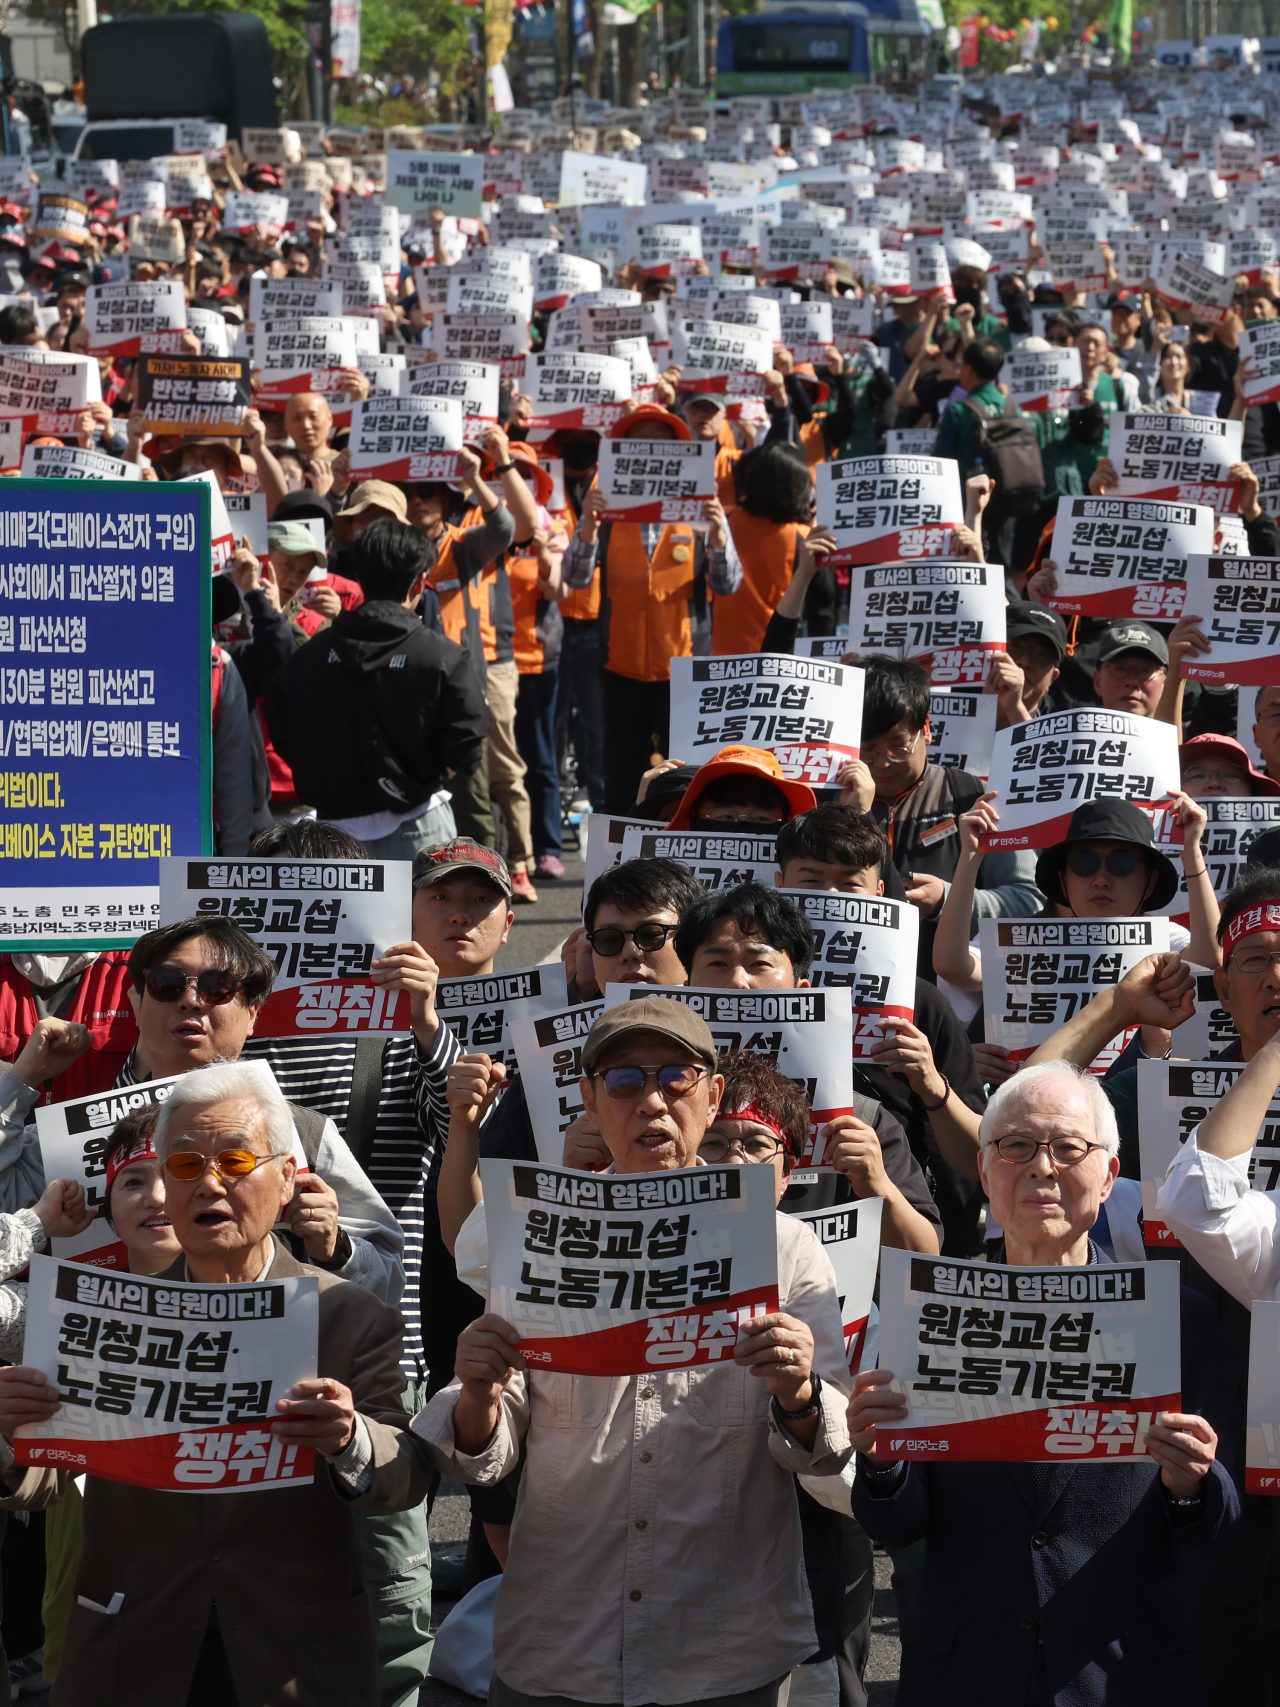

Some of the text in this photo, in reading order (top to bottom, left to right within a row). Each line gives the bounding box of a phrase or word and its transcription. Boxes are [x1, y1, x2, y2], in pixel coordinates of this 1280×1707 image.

[1133, 416, 1222, 437] 열사의 염원이다!
[841, 459, 938, 477] 열사의 염원이다!
[1122, 458, 1221, 481] 노동기본권
[832, 504, 943, 530] 노동기본권
[1083, 502, 1191, 526] 열사의 염원이다!
[156, 513, 195, 552] 구입)
[70, 564, 136, 602] 파산절차
[141, 566, 174, 602] 의결
[872, 568, 981, 585] 열사의 염원이다!
[1065, 552, 1186, 582] 노동기본권
[1222, 561, 1272, 581] 열사의
[20, 616, 87, 653] 파산신청
[860, 620, 983, 648] 노동기본권
[0, 668, 155, 705] 30분 법원 파산선고
[708, 660, 836, 687] 열사의 염원이다!
[147, 721, 180, 757] 통보
[693, 715, 835, 747] 노동기본권
[1024, 712, 1073, 737] 열사의
[1008, 772, 1154, 804] 노동기본권
[60, 823, 94, 859] 자본
[99, 823, 172, 859] 규탄한다!
[207, 865, 374, 890] 열사의 염원이다!
[1011, 925, 1147, 946] 열사의 염원이다!
[1229, 907, 1262, 941] 단결
[259, 942, 375, 979] 기본권
[295, 984, 399, 1029] 쟁취!
[1002, 993, 1099, 1025] 노동기
[535, 1173, 727, 1209] 열사의 염원이다!
[76, 1275, 273, 1320] 열사의 염원이다!
[516, 1258, 732, 1310] 노동기본권
[933, 1266, 1132, 1301] 열사의 염원이다!
[520, 1350, 552, 1362] 주노총
[913, 1355, 1136, 1401] 노동기본권
[57, 1365, 273, 1424] 노동기본권
[173, 1430, 299, 1483] 쟁취!
[907, 1440, 950, 1451] 민주노총
